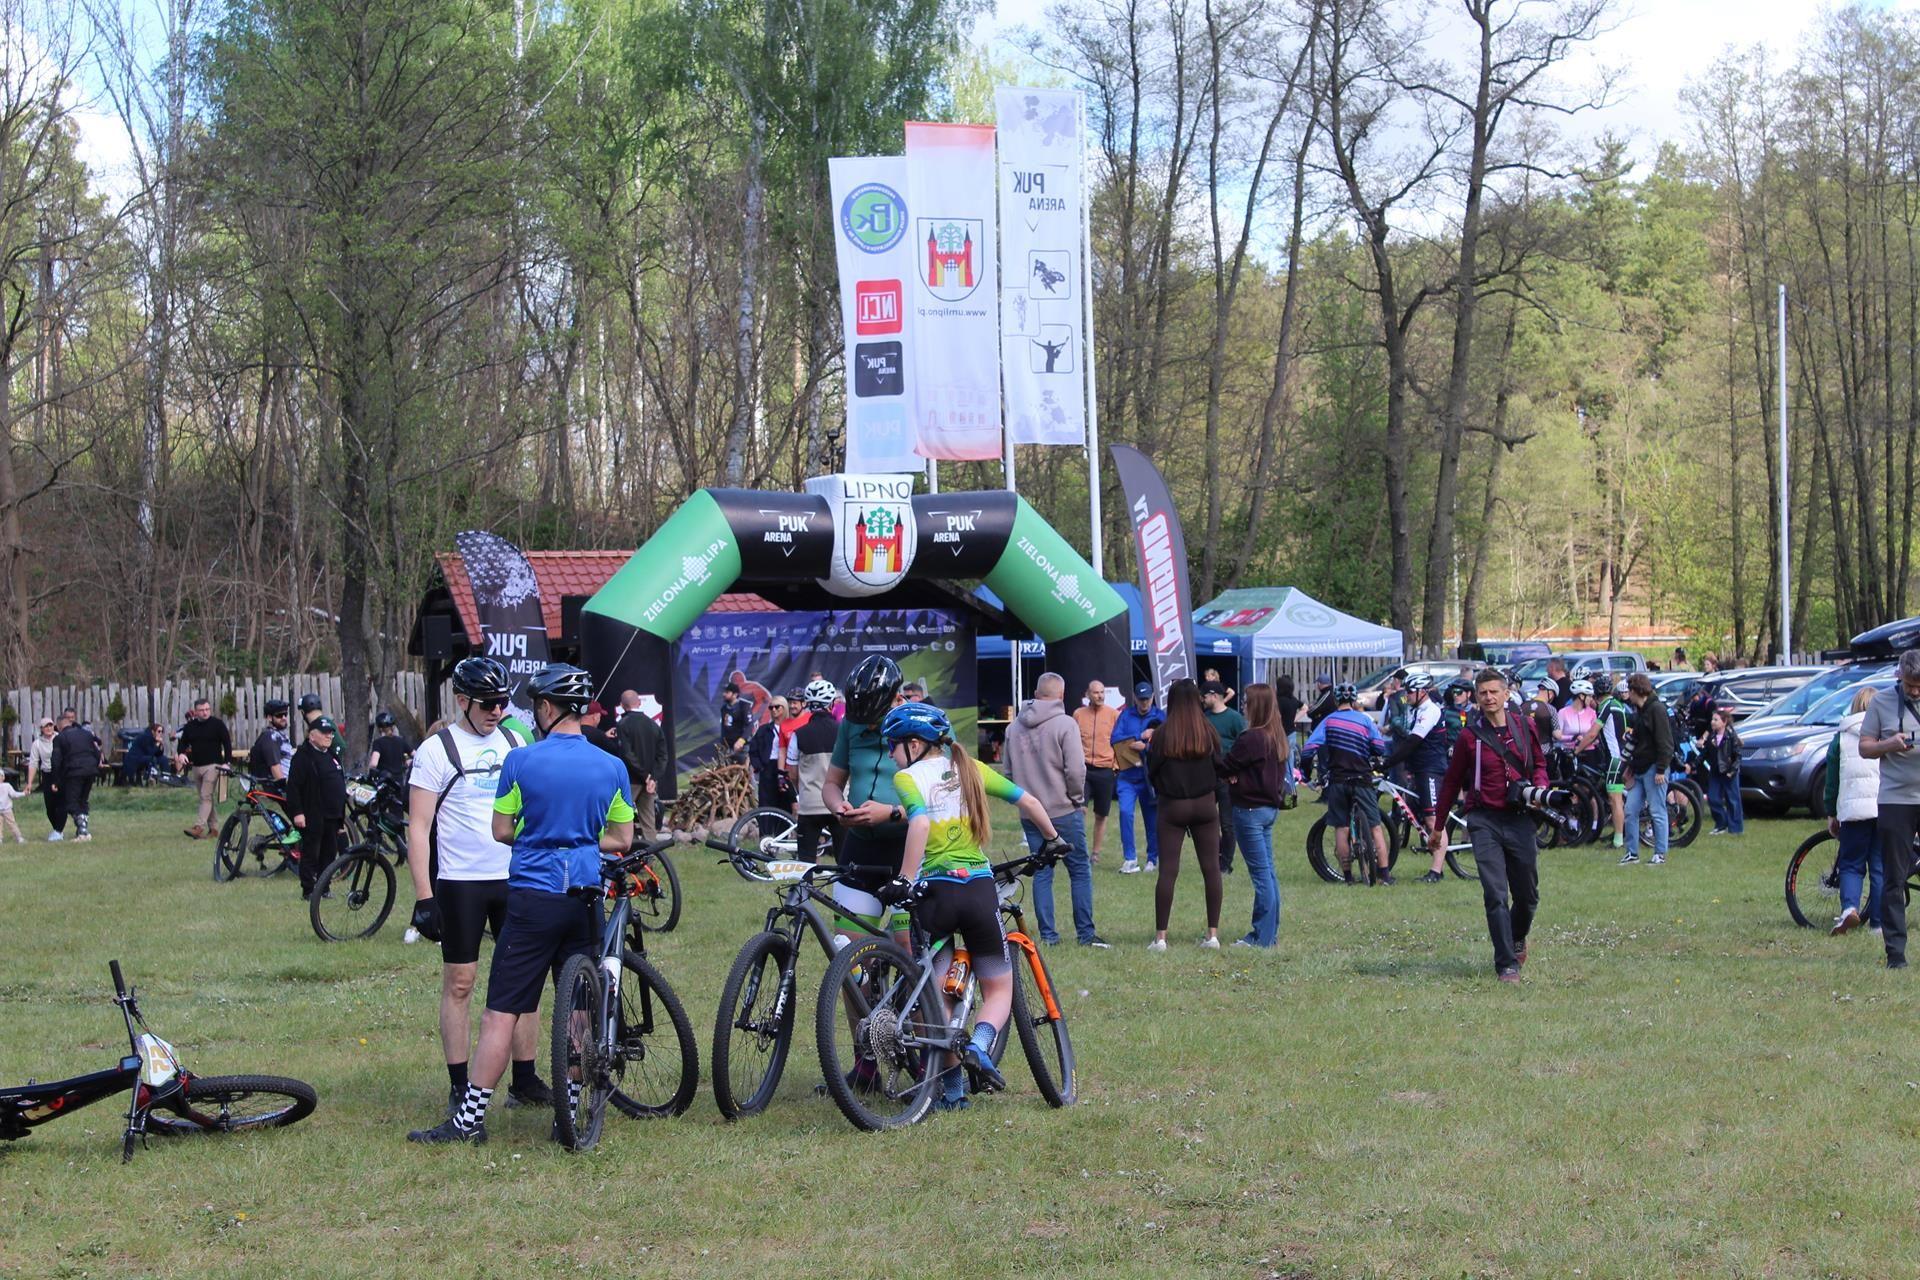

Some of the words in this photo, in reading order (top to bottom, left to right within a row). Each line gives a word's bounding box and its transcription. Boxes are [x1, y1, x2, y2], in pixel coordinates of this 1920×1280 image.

[843, 481, 911, 500] LIPNO
[779, 515, 808, 532] PUK
[946, 515, 975, 532] PUK
[764, 531, 793, 543] ARENA
[933, 532, 961, 543] ARENA
[643, 576, 690, 622] ZIELONA
[702, 539, 728, 563] LIPA
[1016, 536, 1060, 582] ZIELONA
[1073, 592, 1097, 618] LIPA
[1428, 777, 1437, 807] TREK
